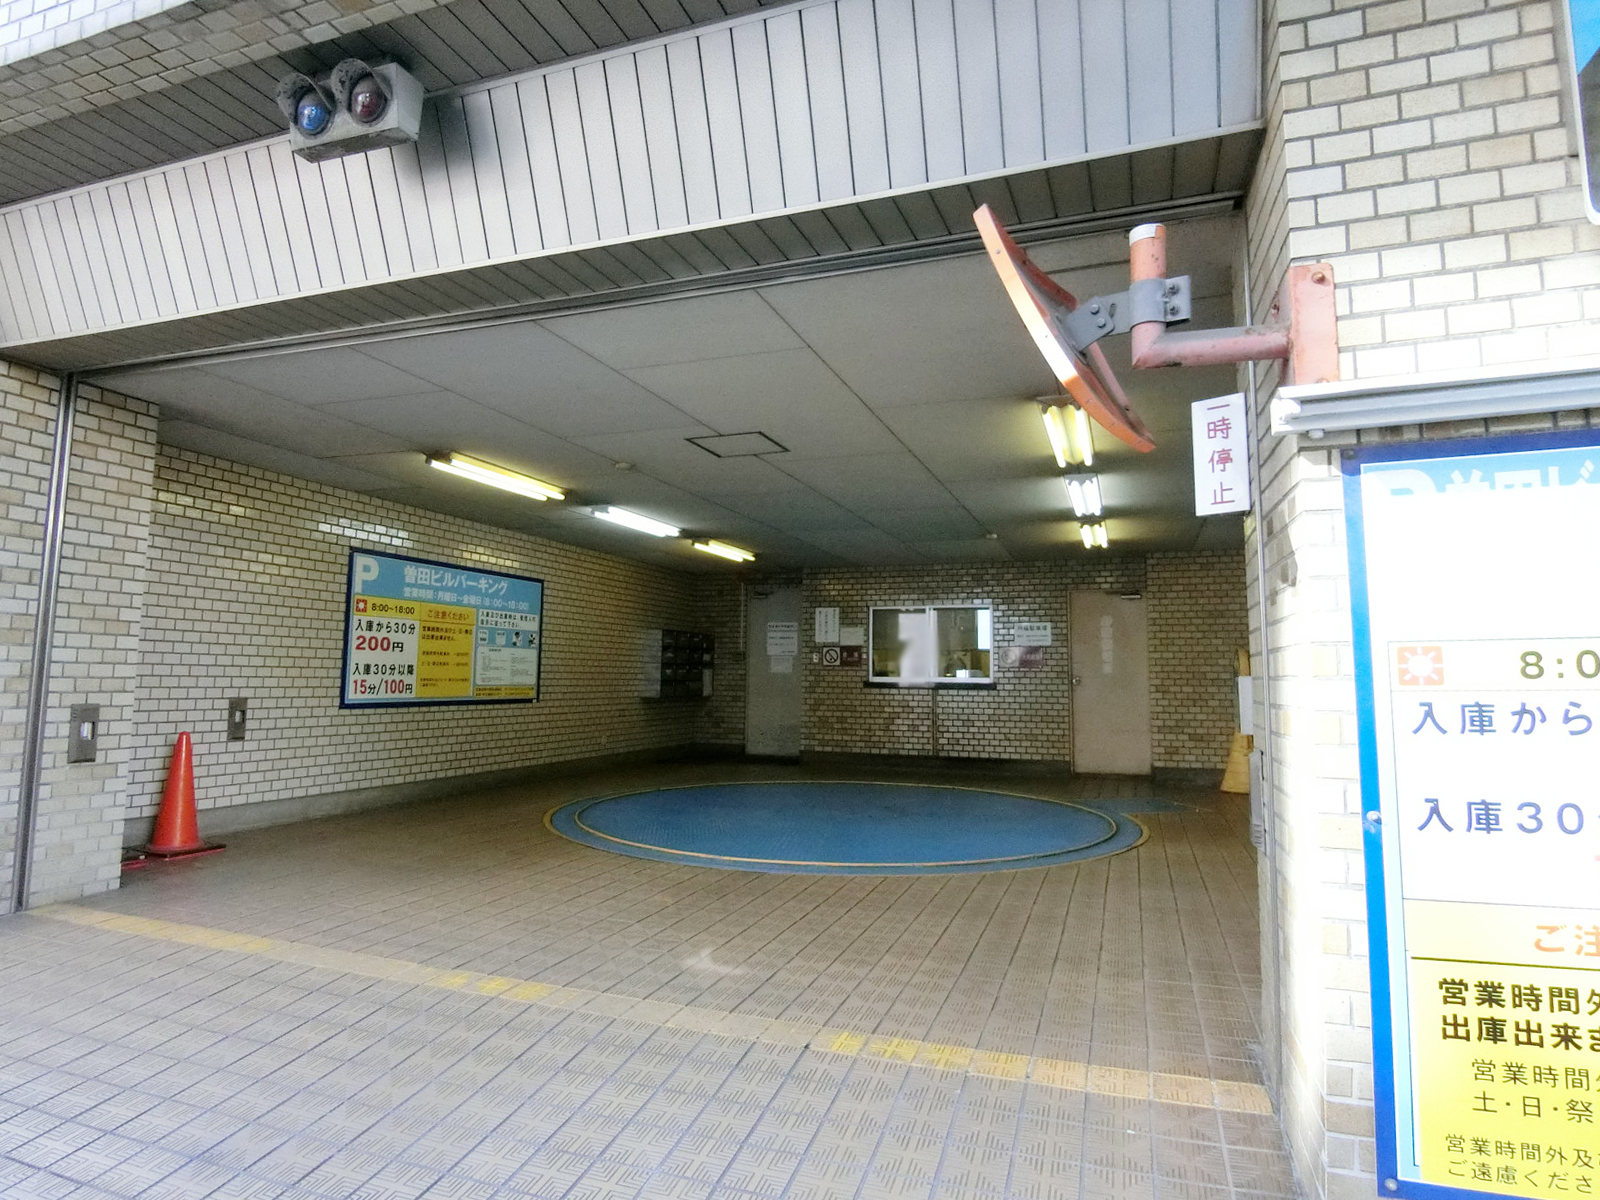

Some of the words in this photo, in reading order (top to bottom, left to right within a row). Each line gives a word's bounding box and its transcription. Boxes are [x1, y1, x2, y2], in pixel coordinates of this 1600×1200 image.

[1206, 403, 1236, 506] 一時停止
[355, 556, 380, 594] P
[355, 619, 416, 635] 入庫から30分
[427, 610, 470, 620] ご注意ください
[355, 635, 404, 653] 200円
[352, 662, 415, 676] 入庫30分以降
[1519, 649, 1600, 680] 8:0
[353, 677, 414, 696] 15分/100円
[1411, 700, 1593, 737] 入庫から
[1416, 797, 1600, 836] 入庫30
[1471, 1058, 1600, 1093] 営業時間
[1445, 1133, 1600, 1169] 営業時間外及
[1448, 1159, 1593, 1194] ご遠慮くださ
